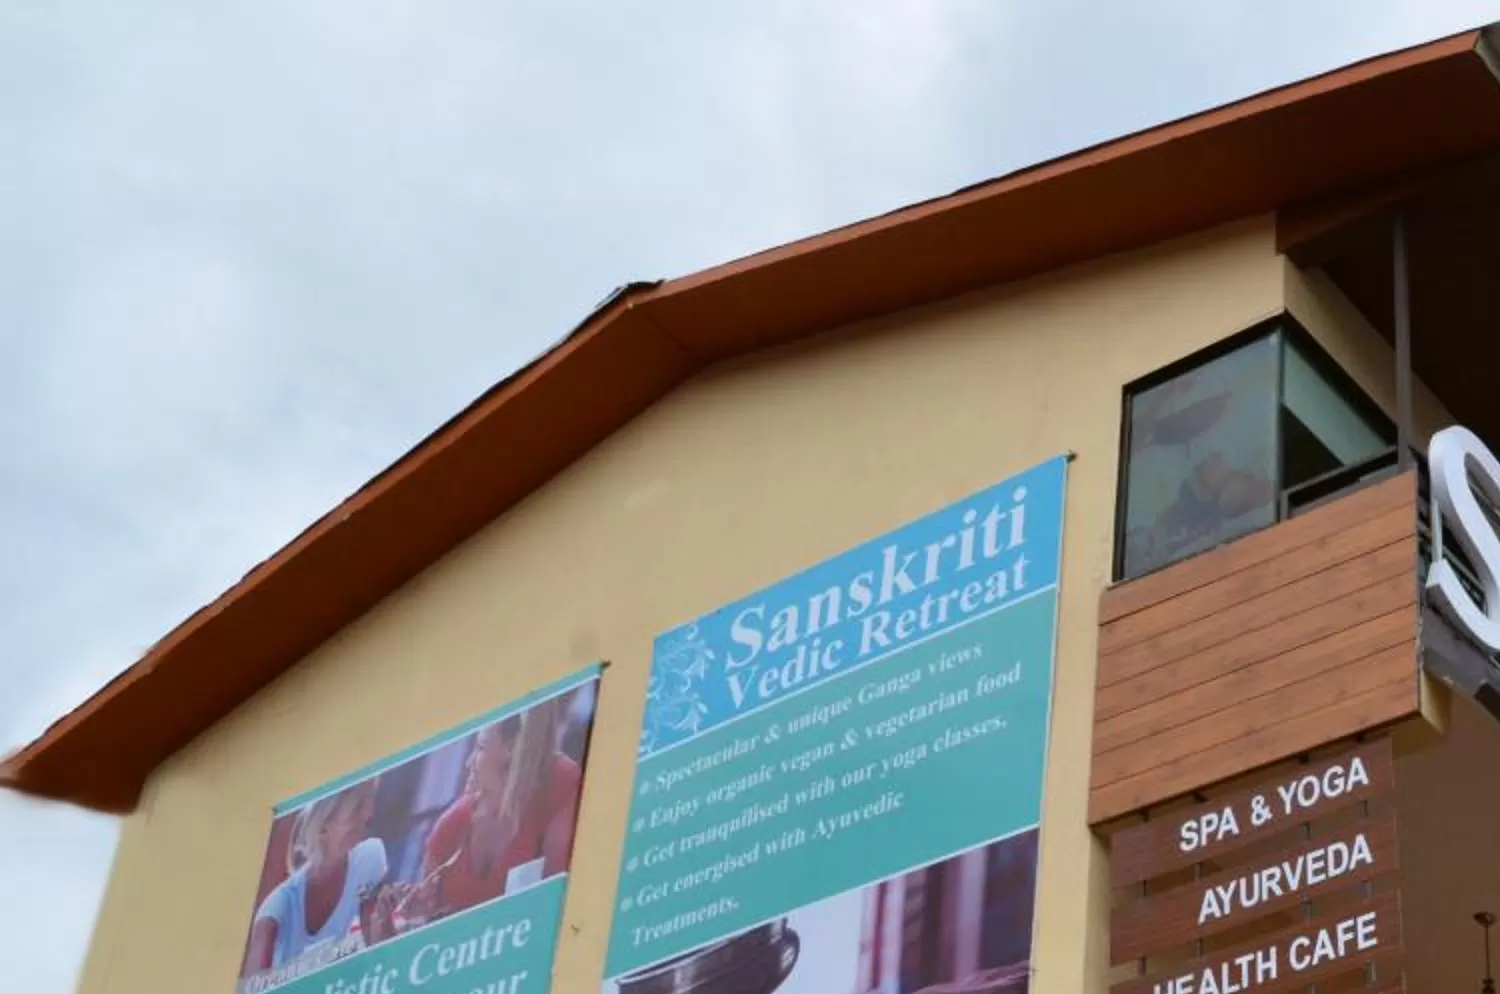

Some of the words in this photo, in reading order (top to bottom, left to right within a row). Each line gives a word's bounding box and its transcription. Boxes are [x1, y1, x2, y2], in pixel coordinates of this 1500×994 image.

[725, 485, 1029, 672] Sanskriti
[725, 637, 844, 709] Vedic
[859, 555, 1031, 658] Retreat
[649, 798, 700, 829] Enjoy
[705, 763, 777, 805] organic
[779, 741, 836, 773] vegan
[839, 727, 859, 751] &
[865, 687, 969, 740] vegetarian
[975, 660, 1022, 697] food
[655, 735, 761, 791] Spectacular
[763, 723, 782, 745] &
[787, 697, 853, 734] unique
[858, 667, 922, 705] Ganga
[928, 643, 983, 676] views
[643, 841, 676, 867] Get
[679, 792, 790, 853] tranquilised
[795, 775, 836, 805] with
[840, 762, 877, 789] our
[879, 743, 928, 779] yoga
[932, 715, 1008, 753] classes.
[1178, 806, 1240, 853] SPA
[1249, 794, 1273, 828] &
[1277, 756, 1370, 817] YOGA
[636, 881, 669, 907] Get
[672, 841, 760, 893] energised
[765, 826, 806, 857] with
[1196, 833, 1374, 926] AYURVEDA
[408, 918, 532, 988] Centre
[1288, 911, 1379, 972] CAFE
